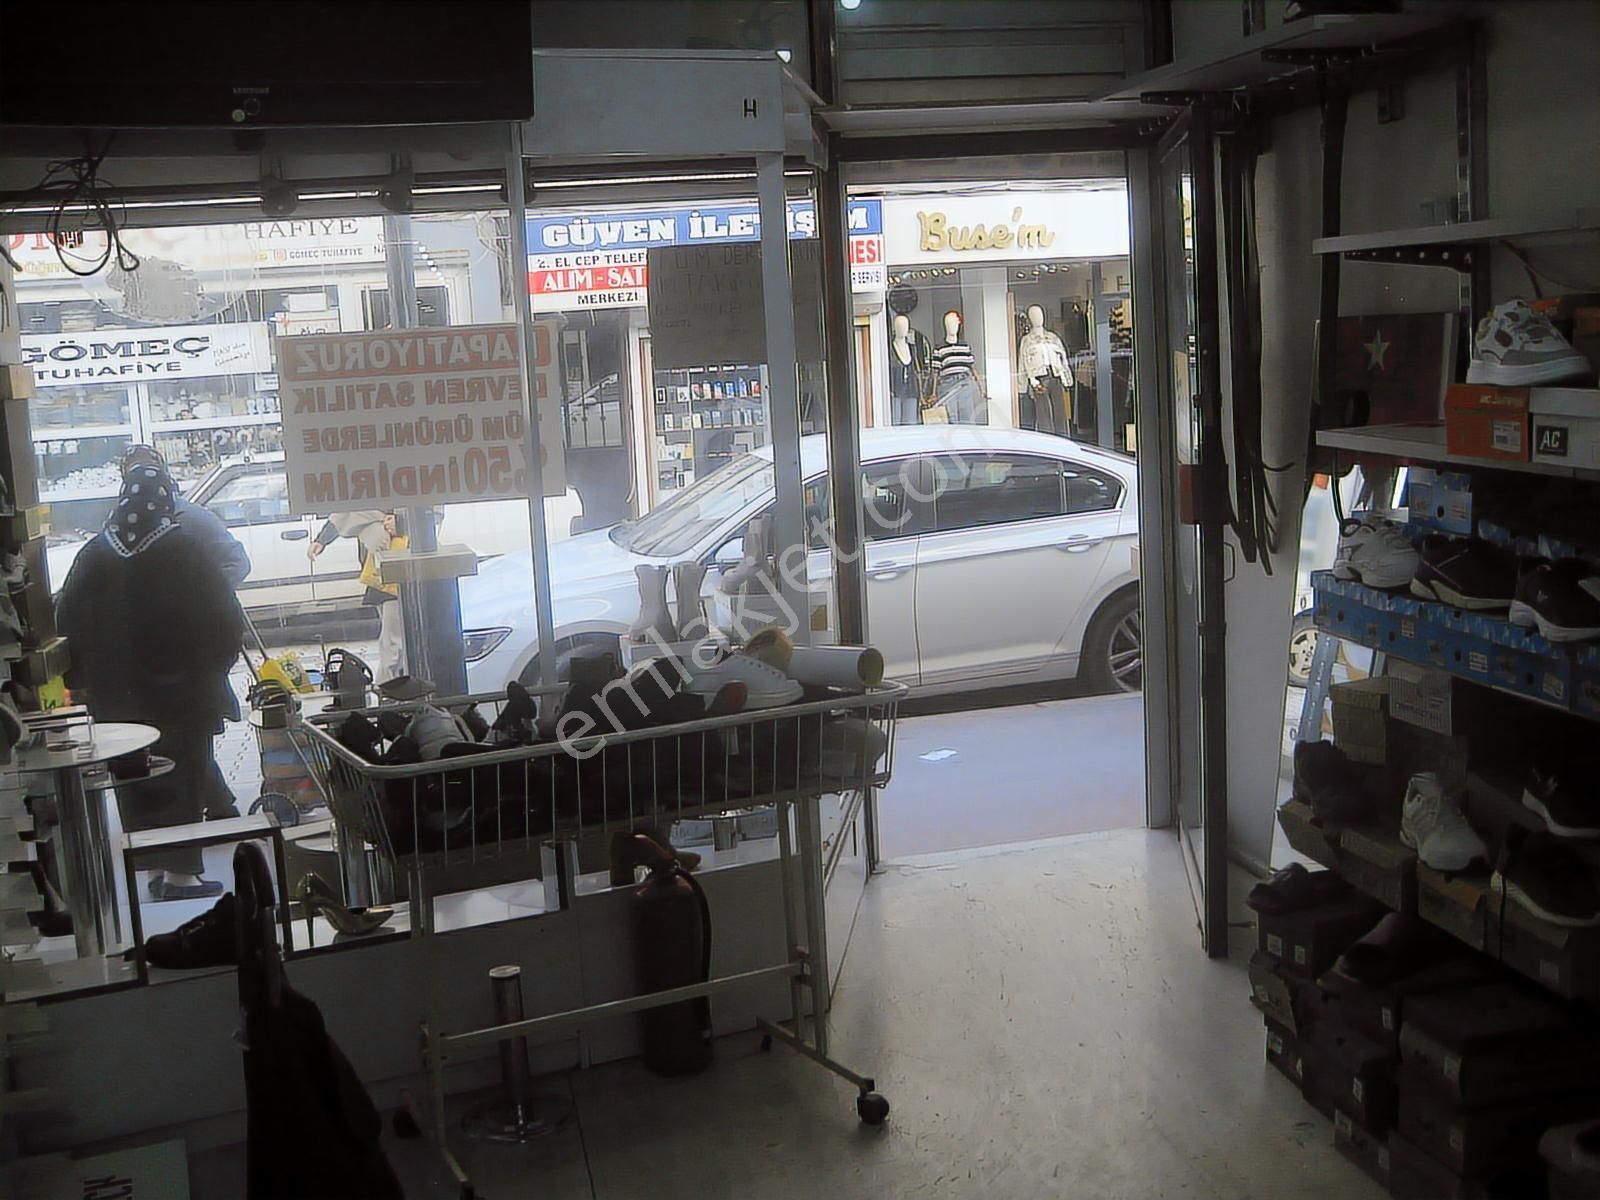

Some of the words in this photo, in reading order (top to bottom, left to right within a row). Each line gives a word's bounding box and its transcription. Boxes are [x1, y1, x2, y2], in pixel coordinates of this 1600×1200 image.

[542, 217, 677, 247] GÜVEN
[917, 206, 1056, 252] Buse'm
[555, 256, 571, 268] EL
[575, 254, 600, 266] CEP
[604, 252, 648, 264] TELEF
[22, 336, 210, 364] GÖMEÇ
[34, 360, 184, 380] TUHAFİYE
